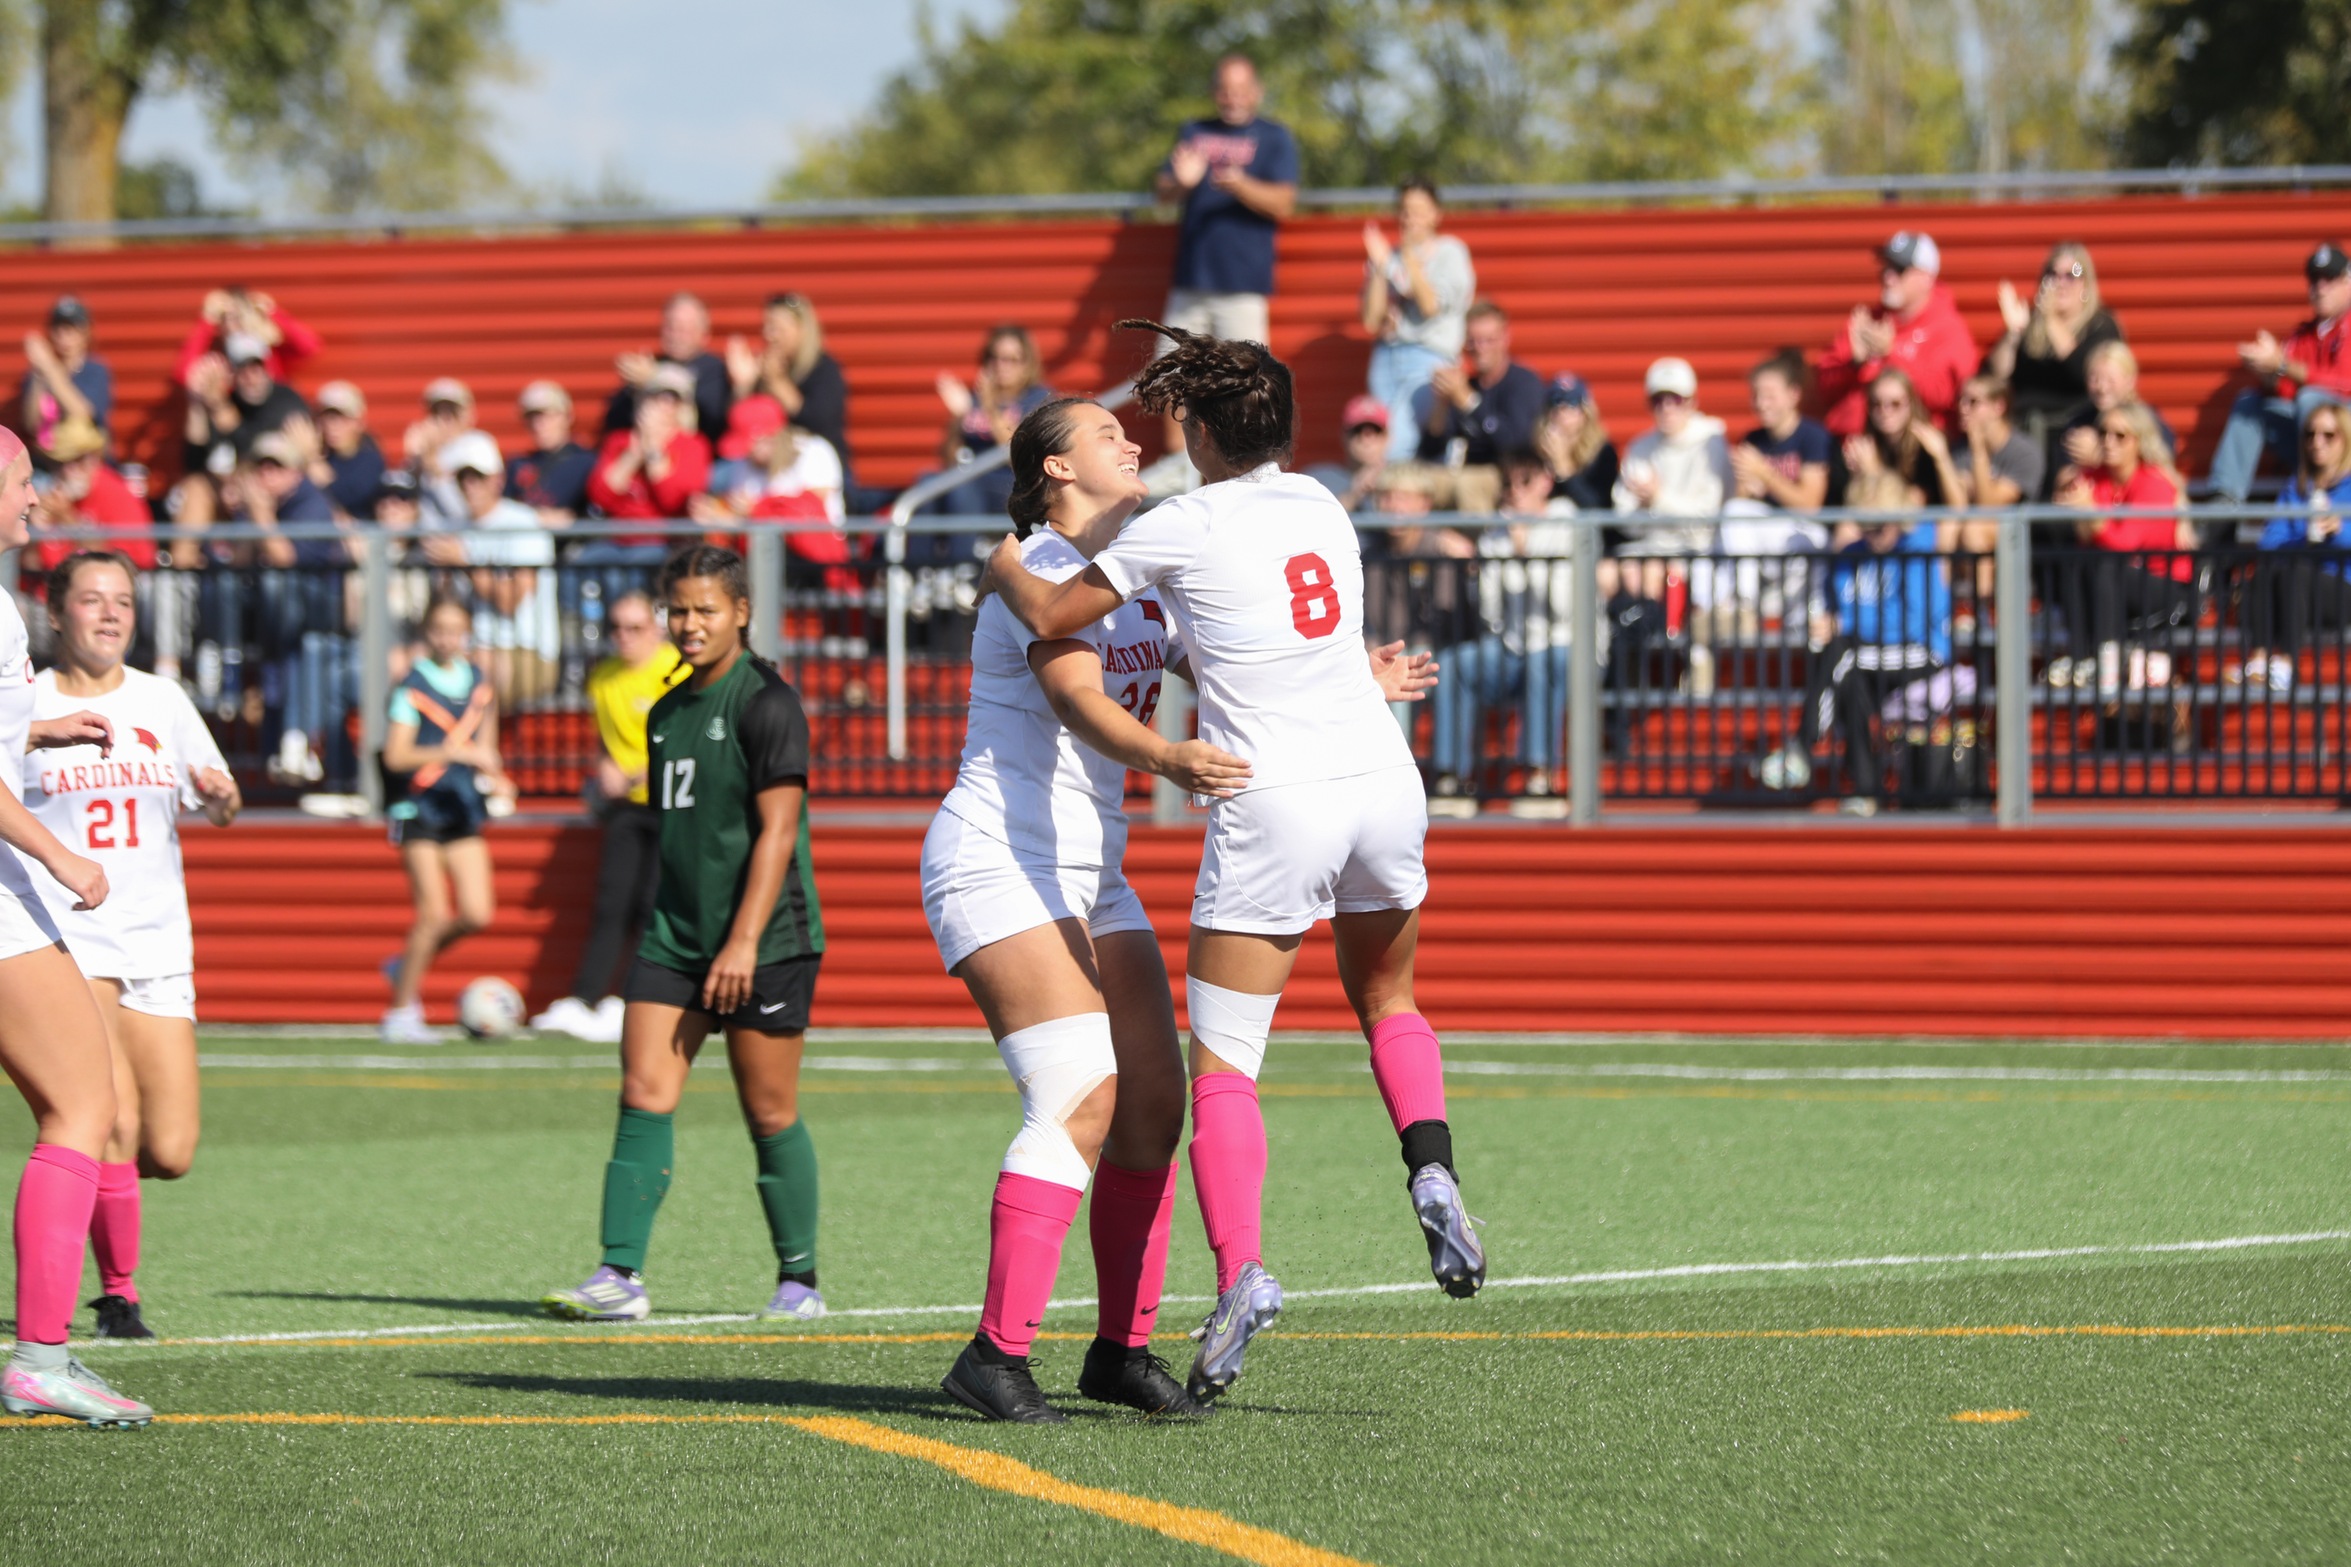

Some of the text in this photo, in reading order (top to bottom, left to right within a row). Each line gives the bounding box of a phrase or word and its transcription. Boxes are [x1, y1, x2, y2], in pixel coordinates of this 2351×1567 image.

[1284, 552, 1341, 640] 8
[1098, 639, 1164, 675] ARDINA
[41, 762, 177, 797] CARDINALS
[661, 757, 696, 810] 12
[87, 798, 139, 849] 21
